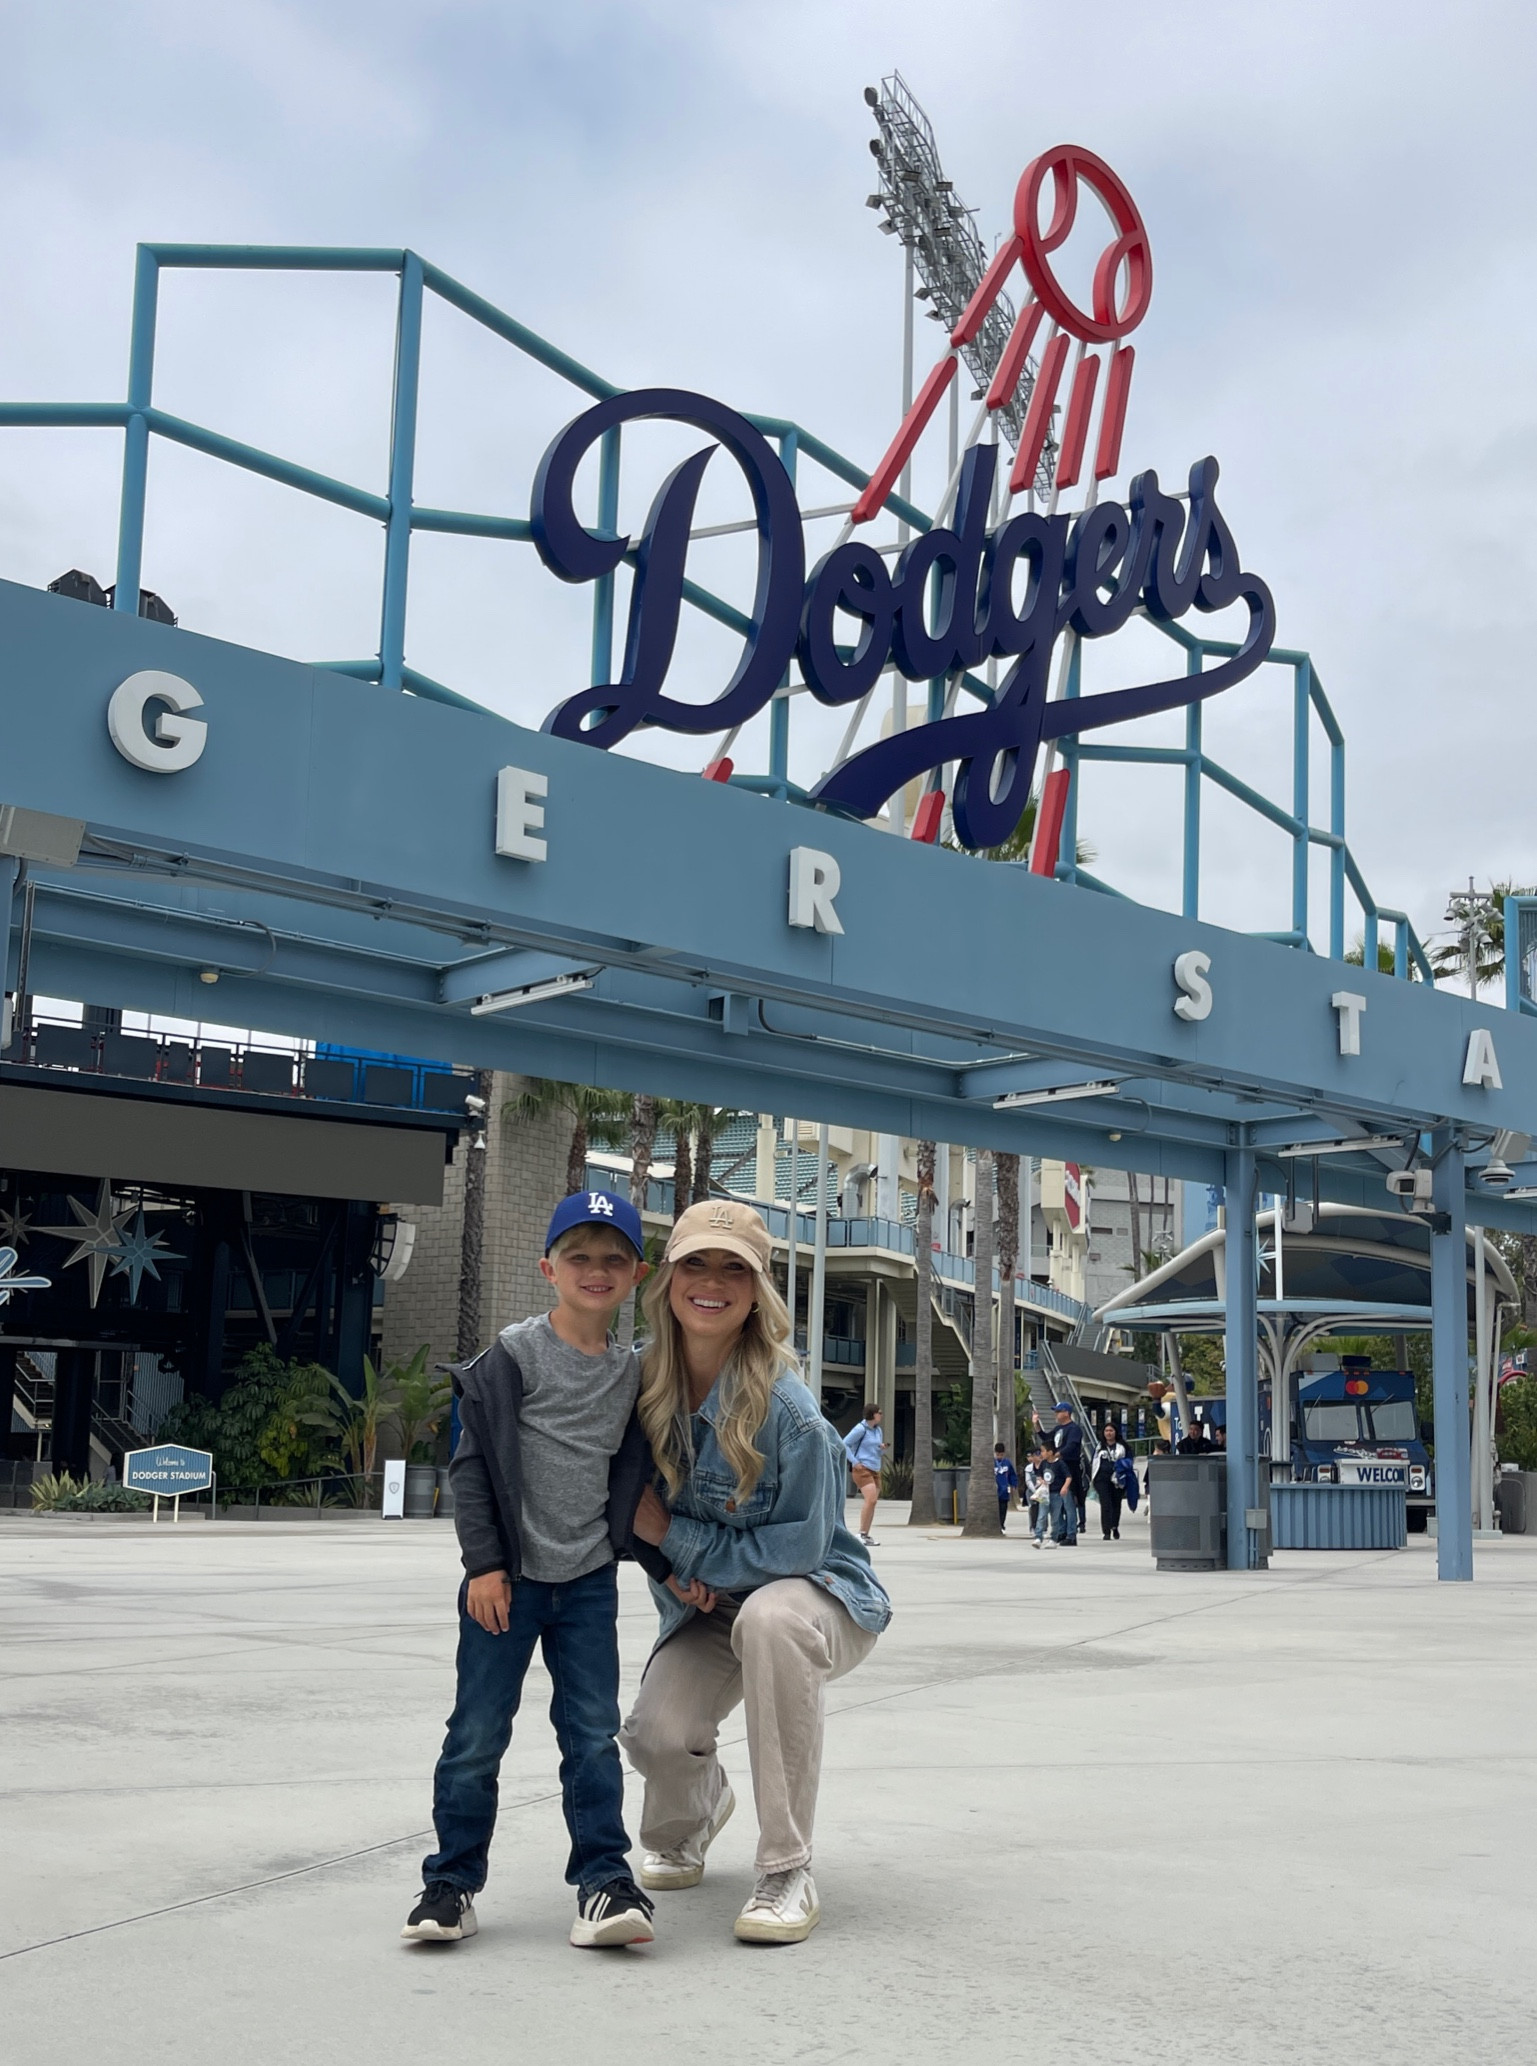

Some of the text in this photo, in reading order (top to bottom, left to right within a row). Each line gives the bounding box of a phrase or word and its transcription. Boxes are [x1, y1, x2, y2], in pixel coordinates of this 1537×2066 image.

[531, 388, 1275, 850] Dodgers
[588, 1192, 613, 1216] LA
[709, 1206, 733, 1230] LA
[132, 1471, 206, 1480] DODGER STADIUM
